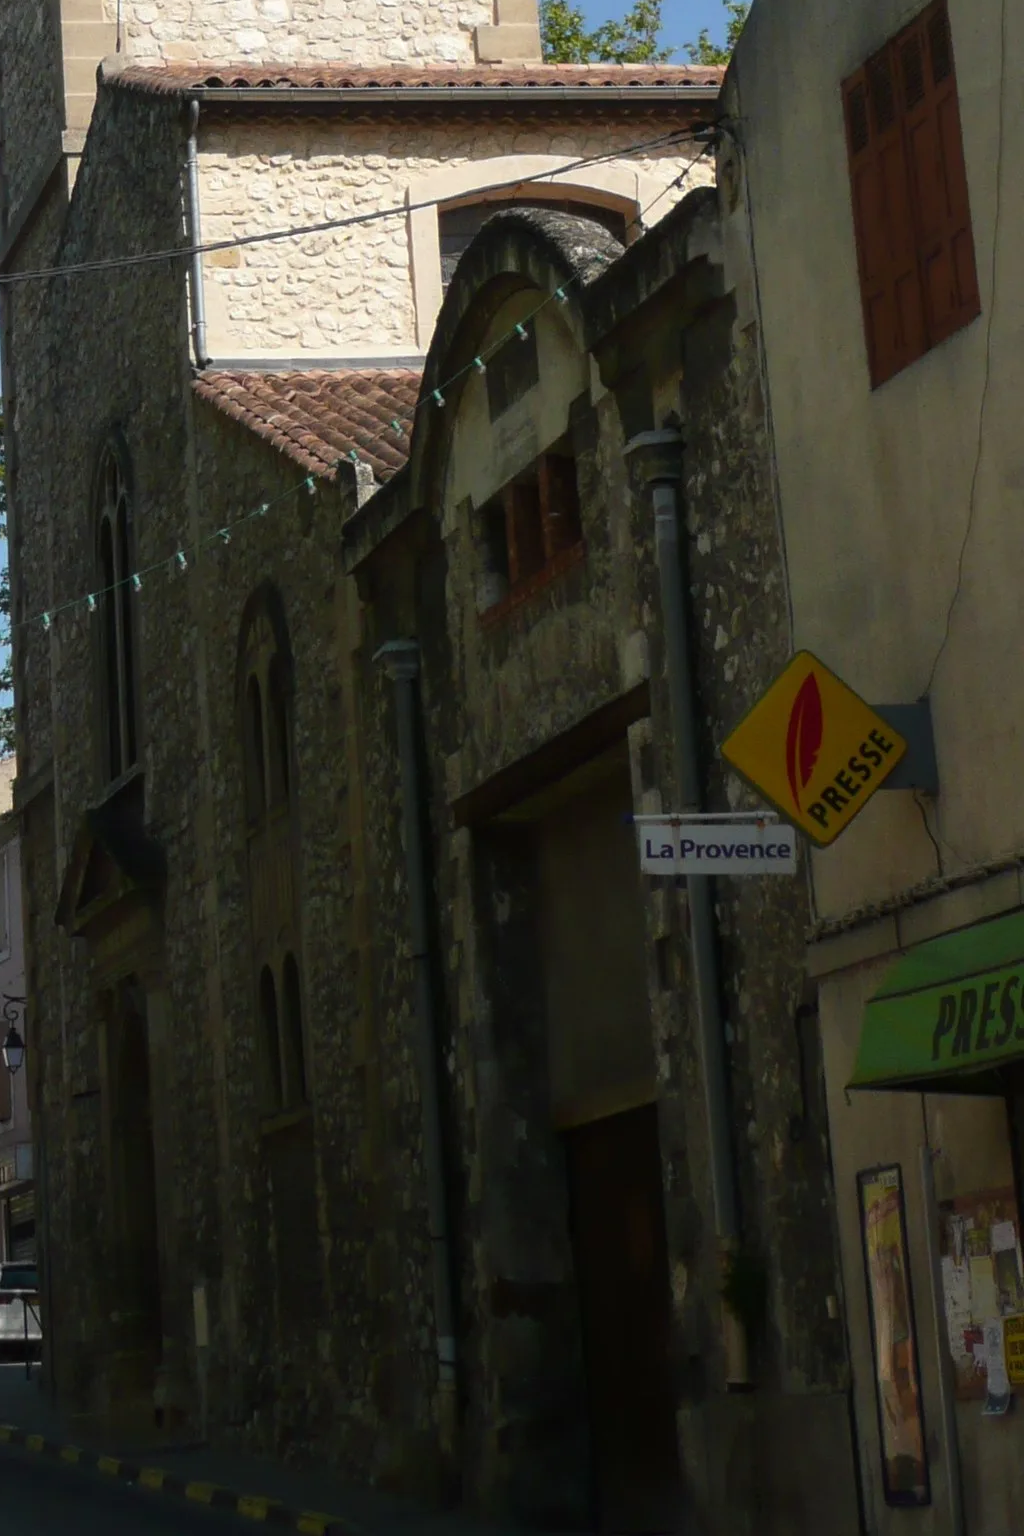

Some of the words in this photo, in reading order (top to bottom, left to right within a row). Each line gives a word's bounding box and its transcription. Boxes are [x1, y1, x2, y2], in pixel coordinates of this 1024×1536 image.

[807, 728, 894, 828] PRESSE
[645, 838, 674, 859] La
[680, 838, 791, 859] Provence
